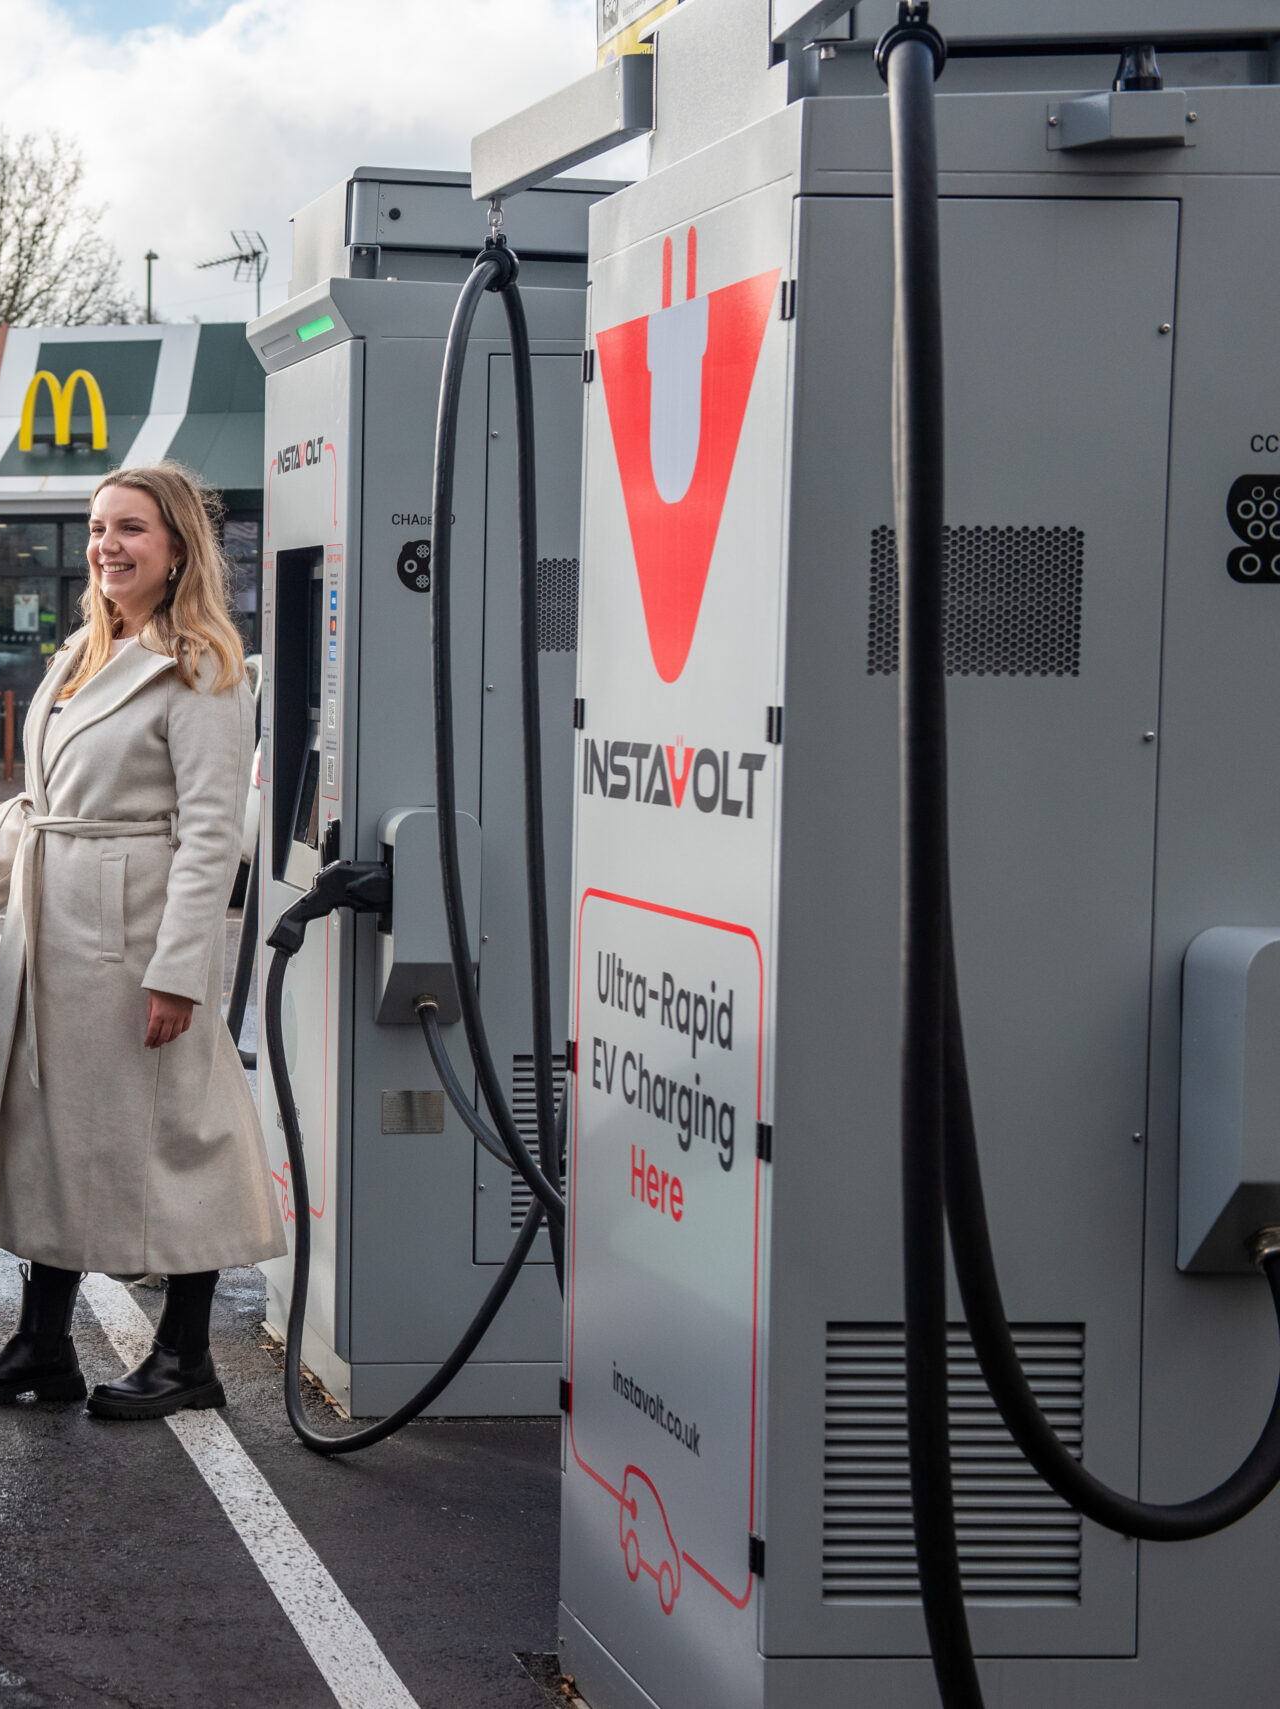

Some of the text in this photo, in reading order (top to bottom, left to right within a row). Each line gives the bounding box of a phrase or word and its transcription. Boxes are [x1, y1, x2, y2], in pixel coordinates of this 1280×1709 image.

[278, 437, 324, 475] INSTAVOLT
[583, 737, 767, 819] INSTAVOLT
[597, 951, 734, 1059] Ultra-Rapid
[592, 1036, 736, 1172] EV Charging
[631, 1143, 684, 1222] Here
[612, 1360, 701, 1458] instavolt.co.uk
